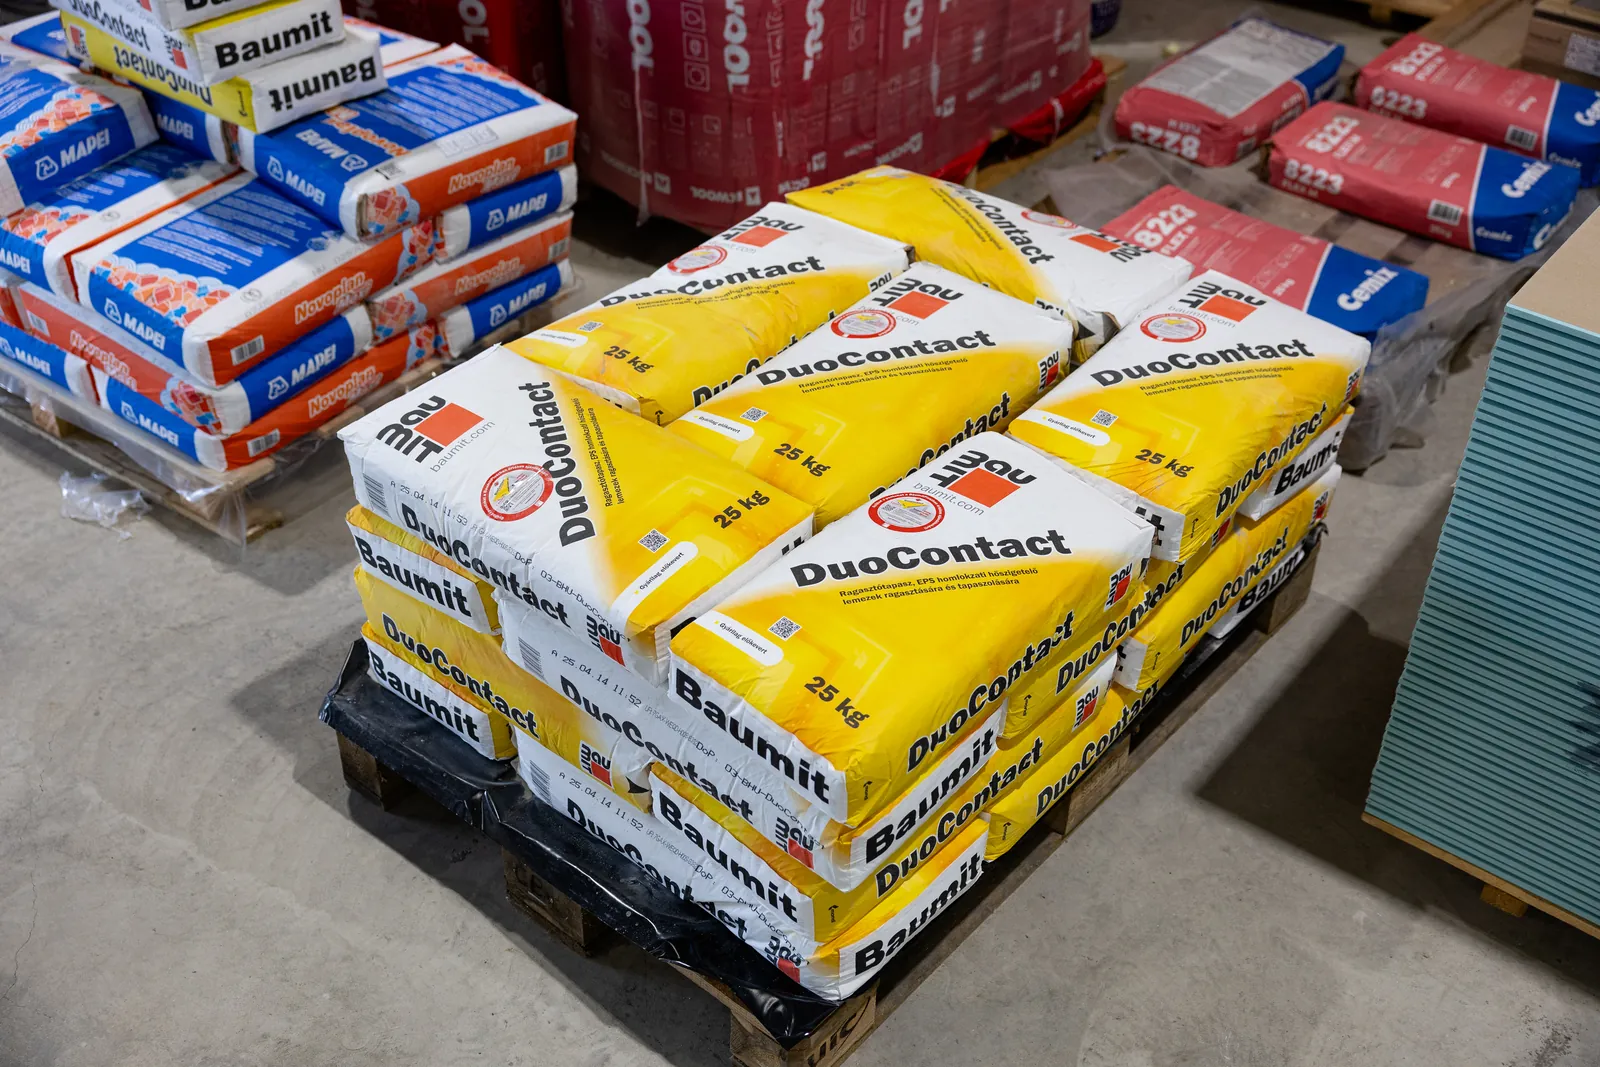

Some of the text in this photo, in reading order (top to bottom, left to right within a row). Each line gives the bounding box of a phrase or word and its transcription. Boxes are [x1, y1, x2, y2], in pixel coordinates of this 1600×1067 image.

[215, 11, 333, 69] Baumit
[269, 56, 377, 112] Baumit
[60, 128, 110, 168] MAPEI
[1130, 120, 1201, 160] 8223
[286, 169, 326, 207] MAPEI
[448, 157, 516, 194] Novoplan
[1283, 158, 1344, 194] 8223
[1501, 160, 1552, 198] Cemix
[505, 192, 548, 223] MAPEI
[1134, 203, 1198, 248] 8223
[1475, 225, 1513, 243] Cemix
[294, 271, 366, 325] Novoplan
[508, 282, 547, 316] MAPEI
[600, 255, 826, 308] DuoContact
[1336, 266, 1400, 312] Cemix
[124, 312, 166, 350] MAPEI
[1167, 305, 1237, 329] baumit.com
[15, 346, 51, 376] MAPEI
[291, 343, 337, 387] MAPEI
[604, 345, 655, 374] 25 kg
[756, 330, 997, 386] DuoContact
[798, 373, 862, 390] Ragasztótapasz,
[863, 369, 880, 377] EPS
[881, 362, 924, 374] homlokzati
[801, 366, 953, 394] lemezek ragasztására és tapaszolására
[1090, 338, 1315, 387] DuoContact
[308, 365, 376, 419] Novoplan
[1144, 373, 1282, 397] lemezek ragasztására és tapaszolására
[138, 413, 180, 447] MAPEI
[429, 420, 496, 474] baumit.com
[518, 381, 596, 547] DuoContact
[589, 450, 598, 461] EPS
[600, 446, 617, 477] ragasztására
[774, 443, 831, 477] 25 kg
[1135, 448, 1195, 478] 25 kg
[1215, 401, 1327, 519] DuoContact
[400, 486, 439, 509] 25.04.14
[611, 478, 625, 504] lemezek
[713, 490, 770, 529] 25 kg
[913, 482, 985, 517] baumit.com
[354, 535, 472, 618] Baumit
[401, 502, 571, 628] DuoContact
[639, 551, 685, 590] Gyárilag előkevert
[790, 529, 1073, 588] DuoContact
[838, 567, 1038, 598] Ragasztótapasz, EPS homlokzati hőszigetelő
[842, 578, 1020, 605] lemezek ragasztására és tapaszolására
[1179, 527, 1290, 649] DuoContact
[719, 622, 768, 655] Gyárilag előkevert
[1056, 563, 1187, 696] DuoContact
[370, 649, 481, 743] Baumit
[382, 612, 540, 740] DuoContact
[562, 655, 609, 685] 25.04.14
[613, 684, 642, 708] 11:52
[906, 610, 1075, 773] DuoContact
[804, 676, 870, 729] 25 kg
[560, 675, 754, 825] DuoContact
[675, 667, 830, 804] Baumit
[1036, 680, 1159, 818] DuoContact
[568, 779, 612, 809] 25.04.14
[615, 808, 644, 831] 11:52
[865, 727, 995, 864] Baumit
[876, 736, 1043, 899] DuoContact
[659, 791, 798, 923] Baumit
[855, 852, 981, 976] Baumit
